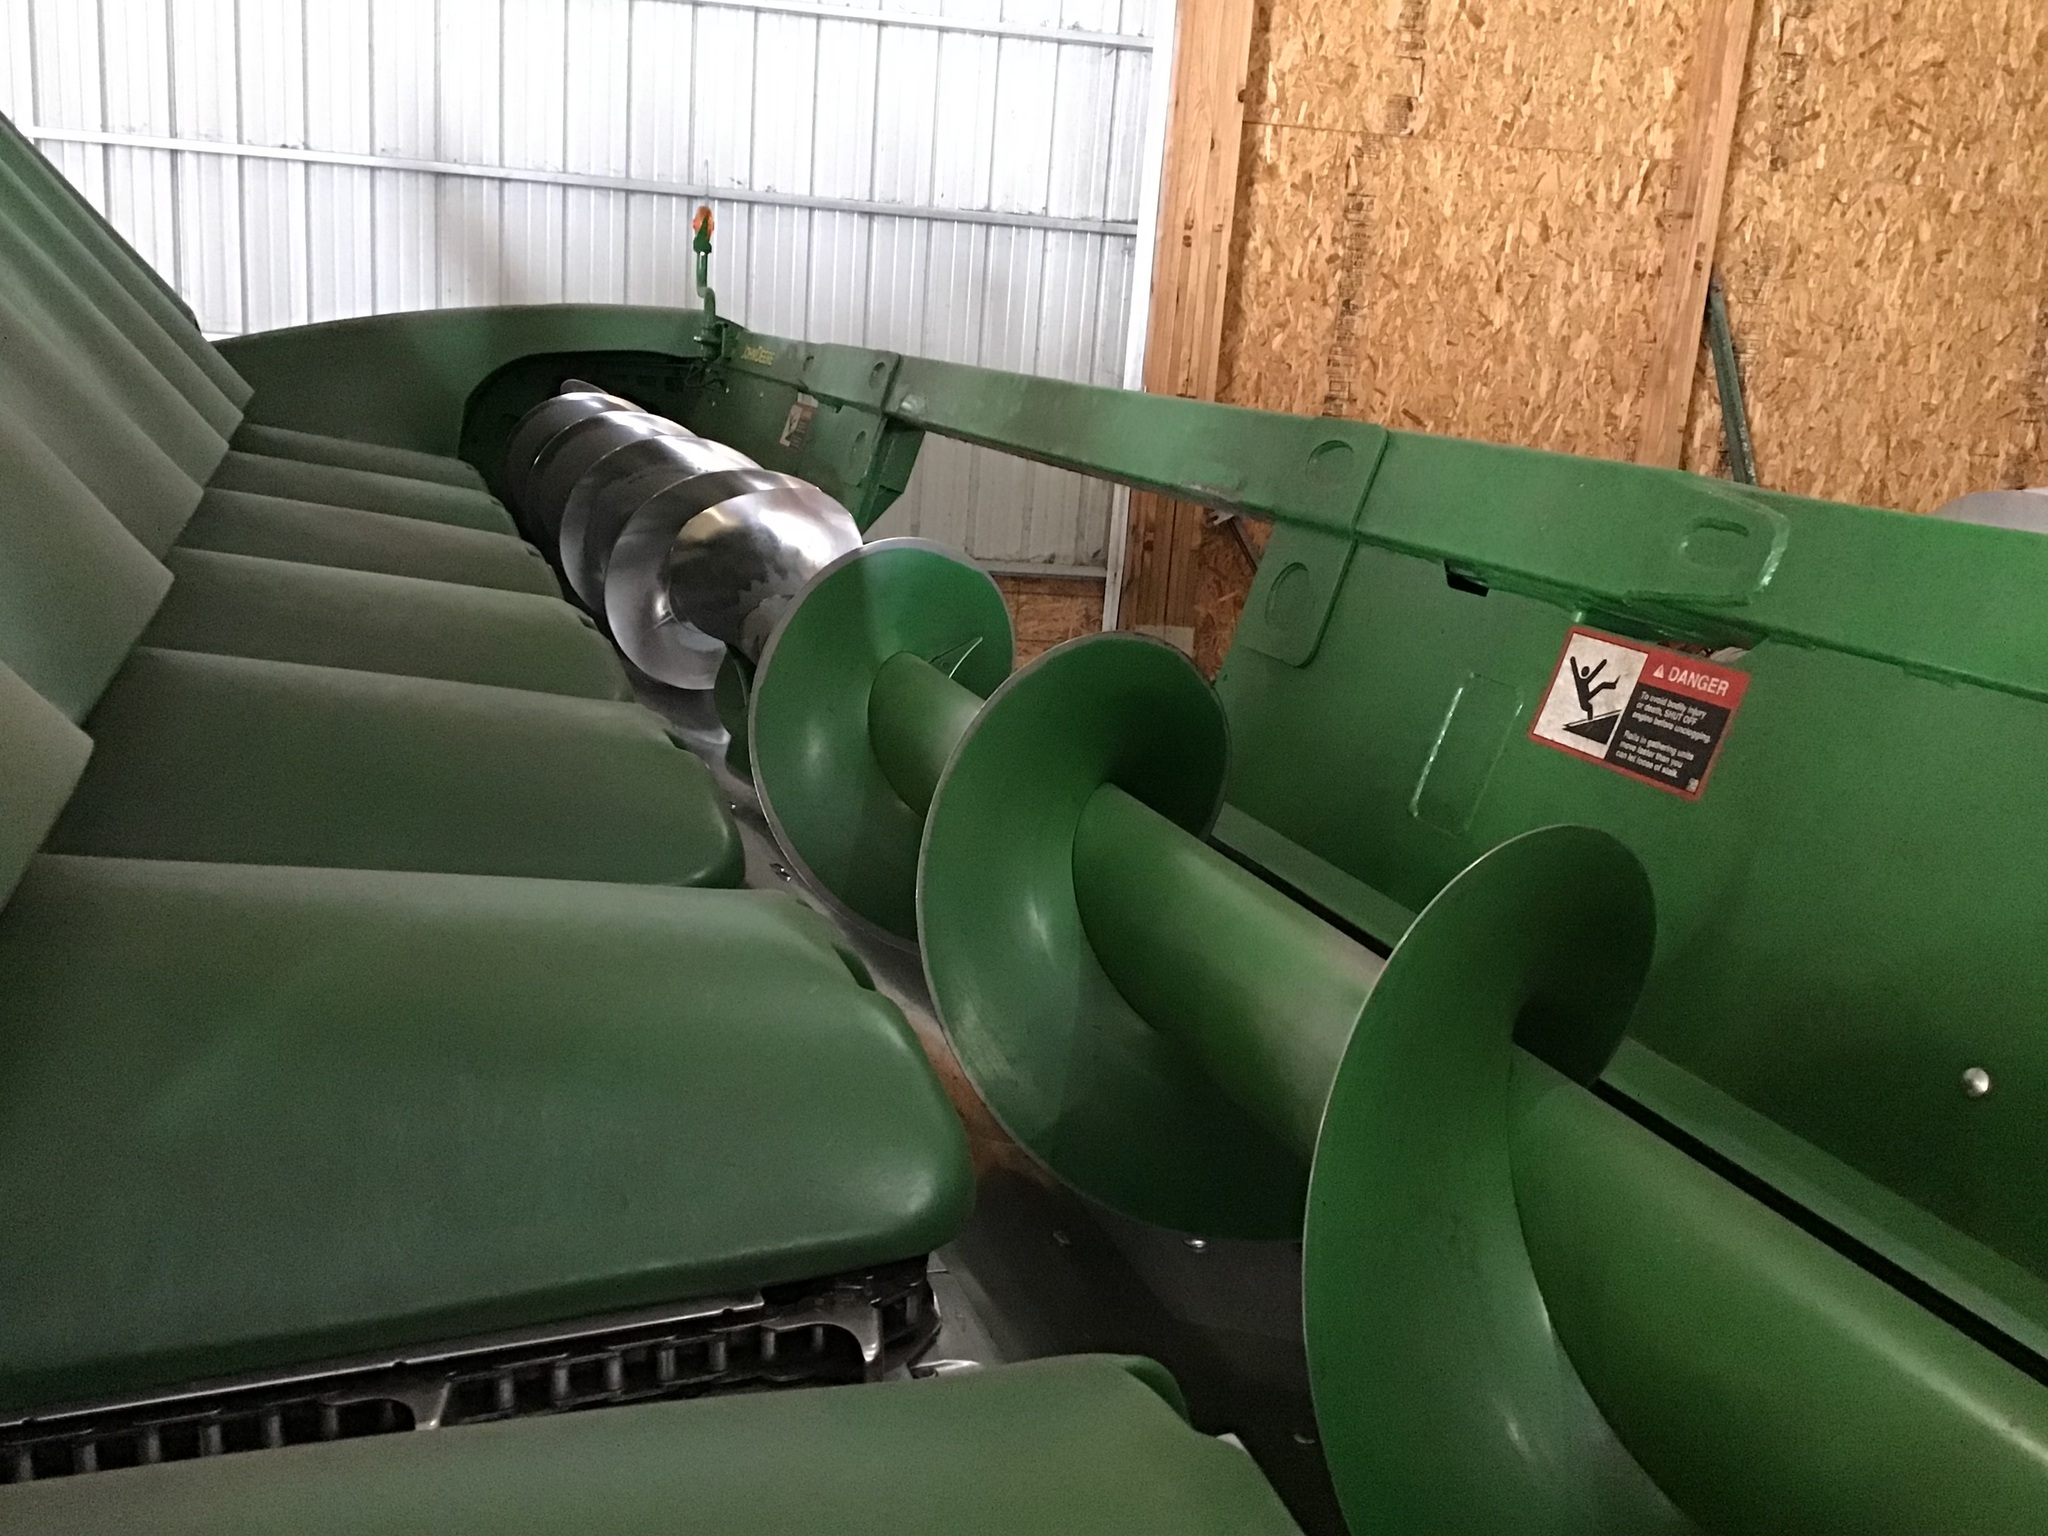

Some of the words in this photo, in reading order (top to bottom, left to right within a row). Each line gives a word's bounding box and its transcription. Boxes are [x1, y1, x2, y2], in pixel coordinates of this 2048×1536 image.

[1668, 667, 1729, 696] DANGER
[1641, 691, 1649, 700] To
[1650, 695, 1667, 705] avoid
[1667, 700, 1686, 713] bodily
[1687, 706, 1707, 720] injury
[1632, 712, 1653, 723] engine
[1653, 717, 1674, 730] before
[1664, 709, 1684, 721] SHUT
[1683, 715, 1698, 726] OFF
[1619, 741, 1636, 752] move
[1637, 746, 1655, 758] faster
[1655, 753, 1670, 763] than
[1670, 758, 1684, 768] you
[1646, 740, 1677, 756] gathering
[1616, 750, 1628, 759] can
[1627, 754, 1636, 762] let
[1636, 757, 1654, 769] loose
